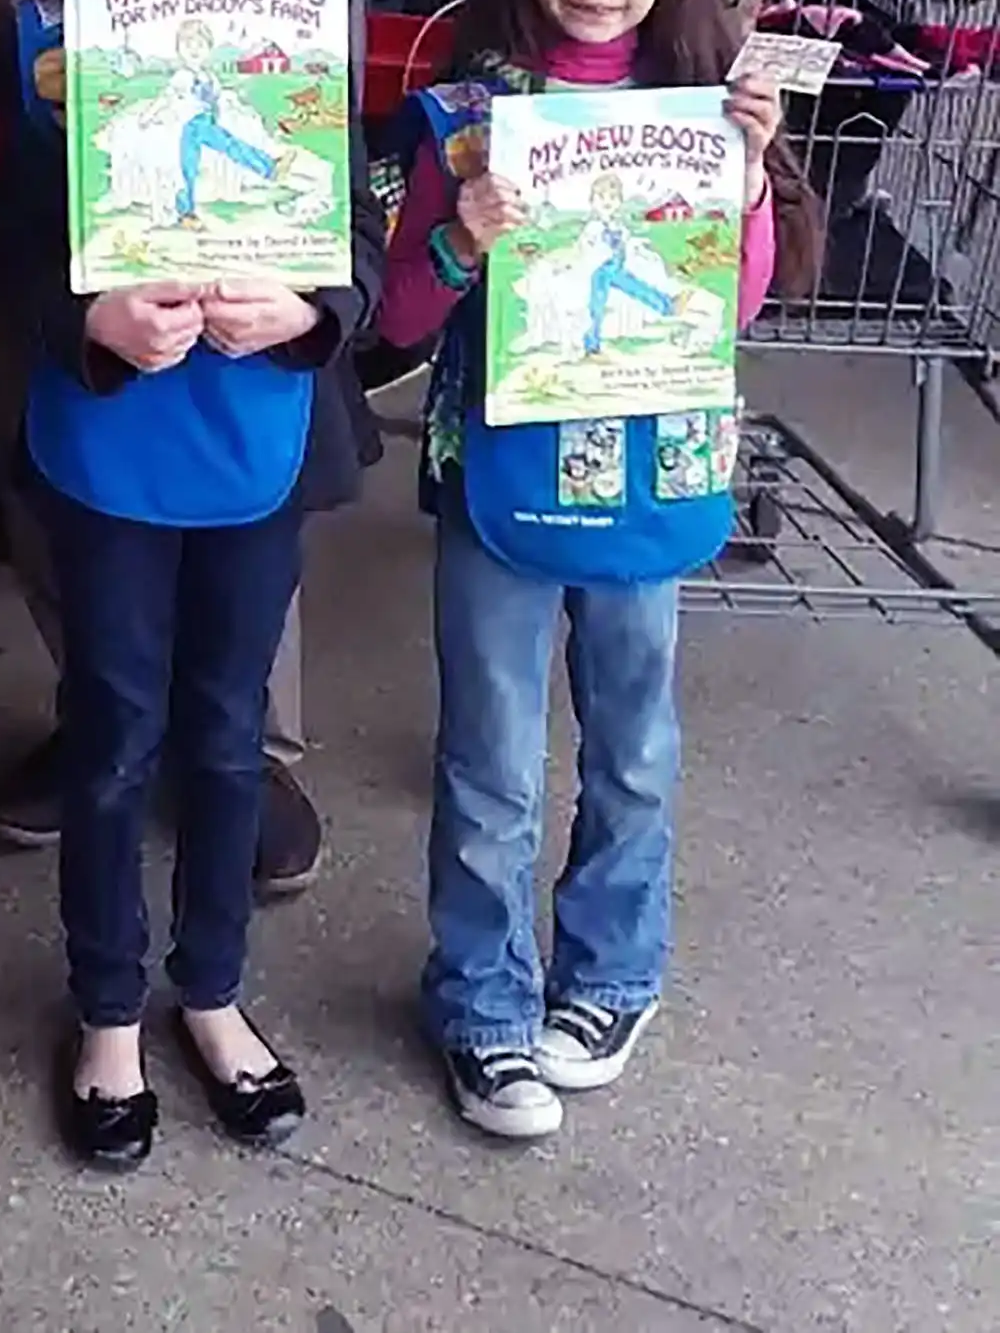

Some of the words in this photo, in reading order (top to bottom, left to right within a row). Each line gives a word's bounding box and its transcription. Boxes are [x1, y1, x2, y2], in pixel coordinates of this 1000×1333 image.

[111, 7, 146, 31] FOR
[271, 0, 321, 28] FARM
[529, 134, 568, 170] MY
[576, 125, 634, 155] NEW
[641, 124, 727, 159] BOOTS
